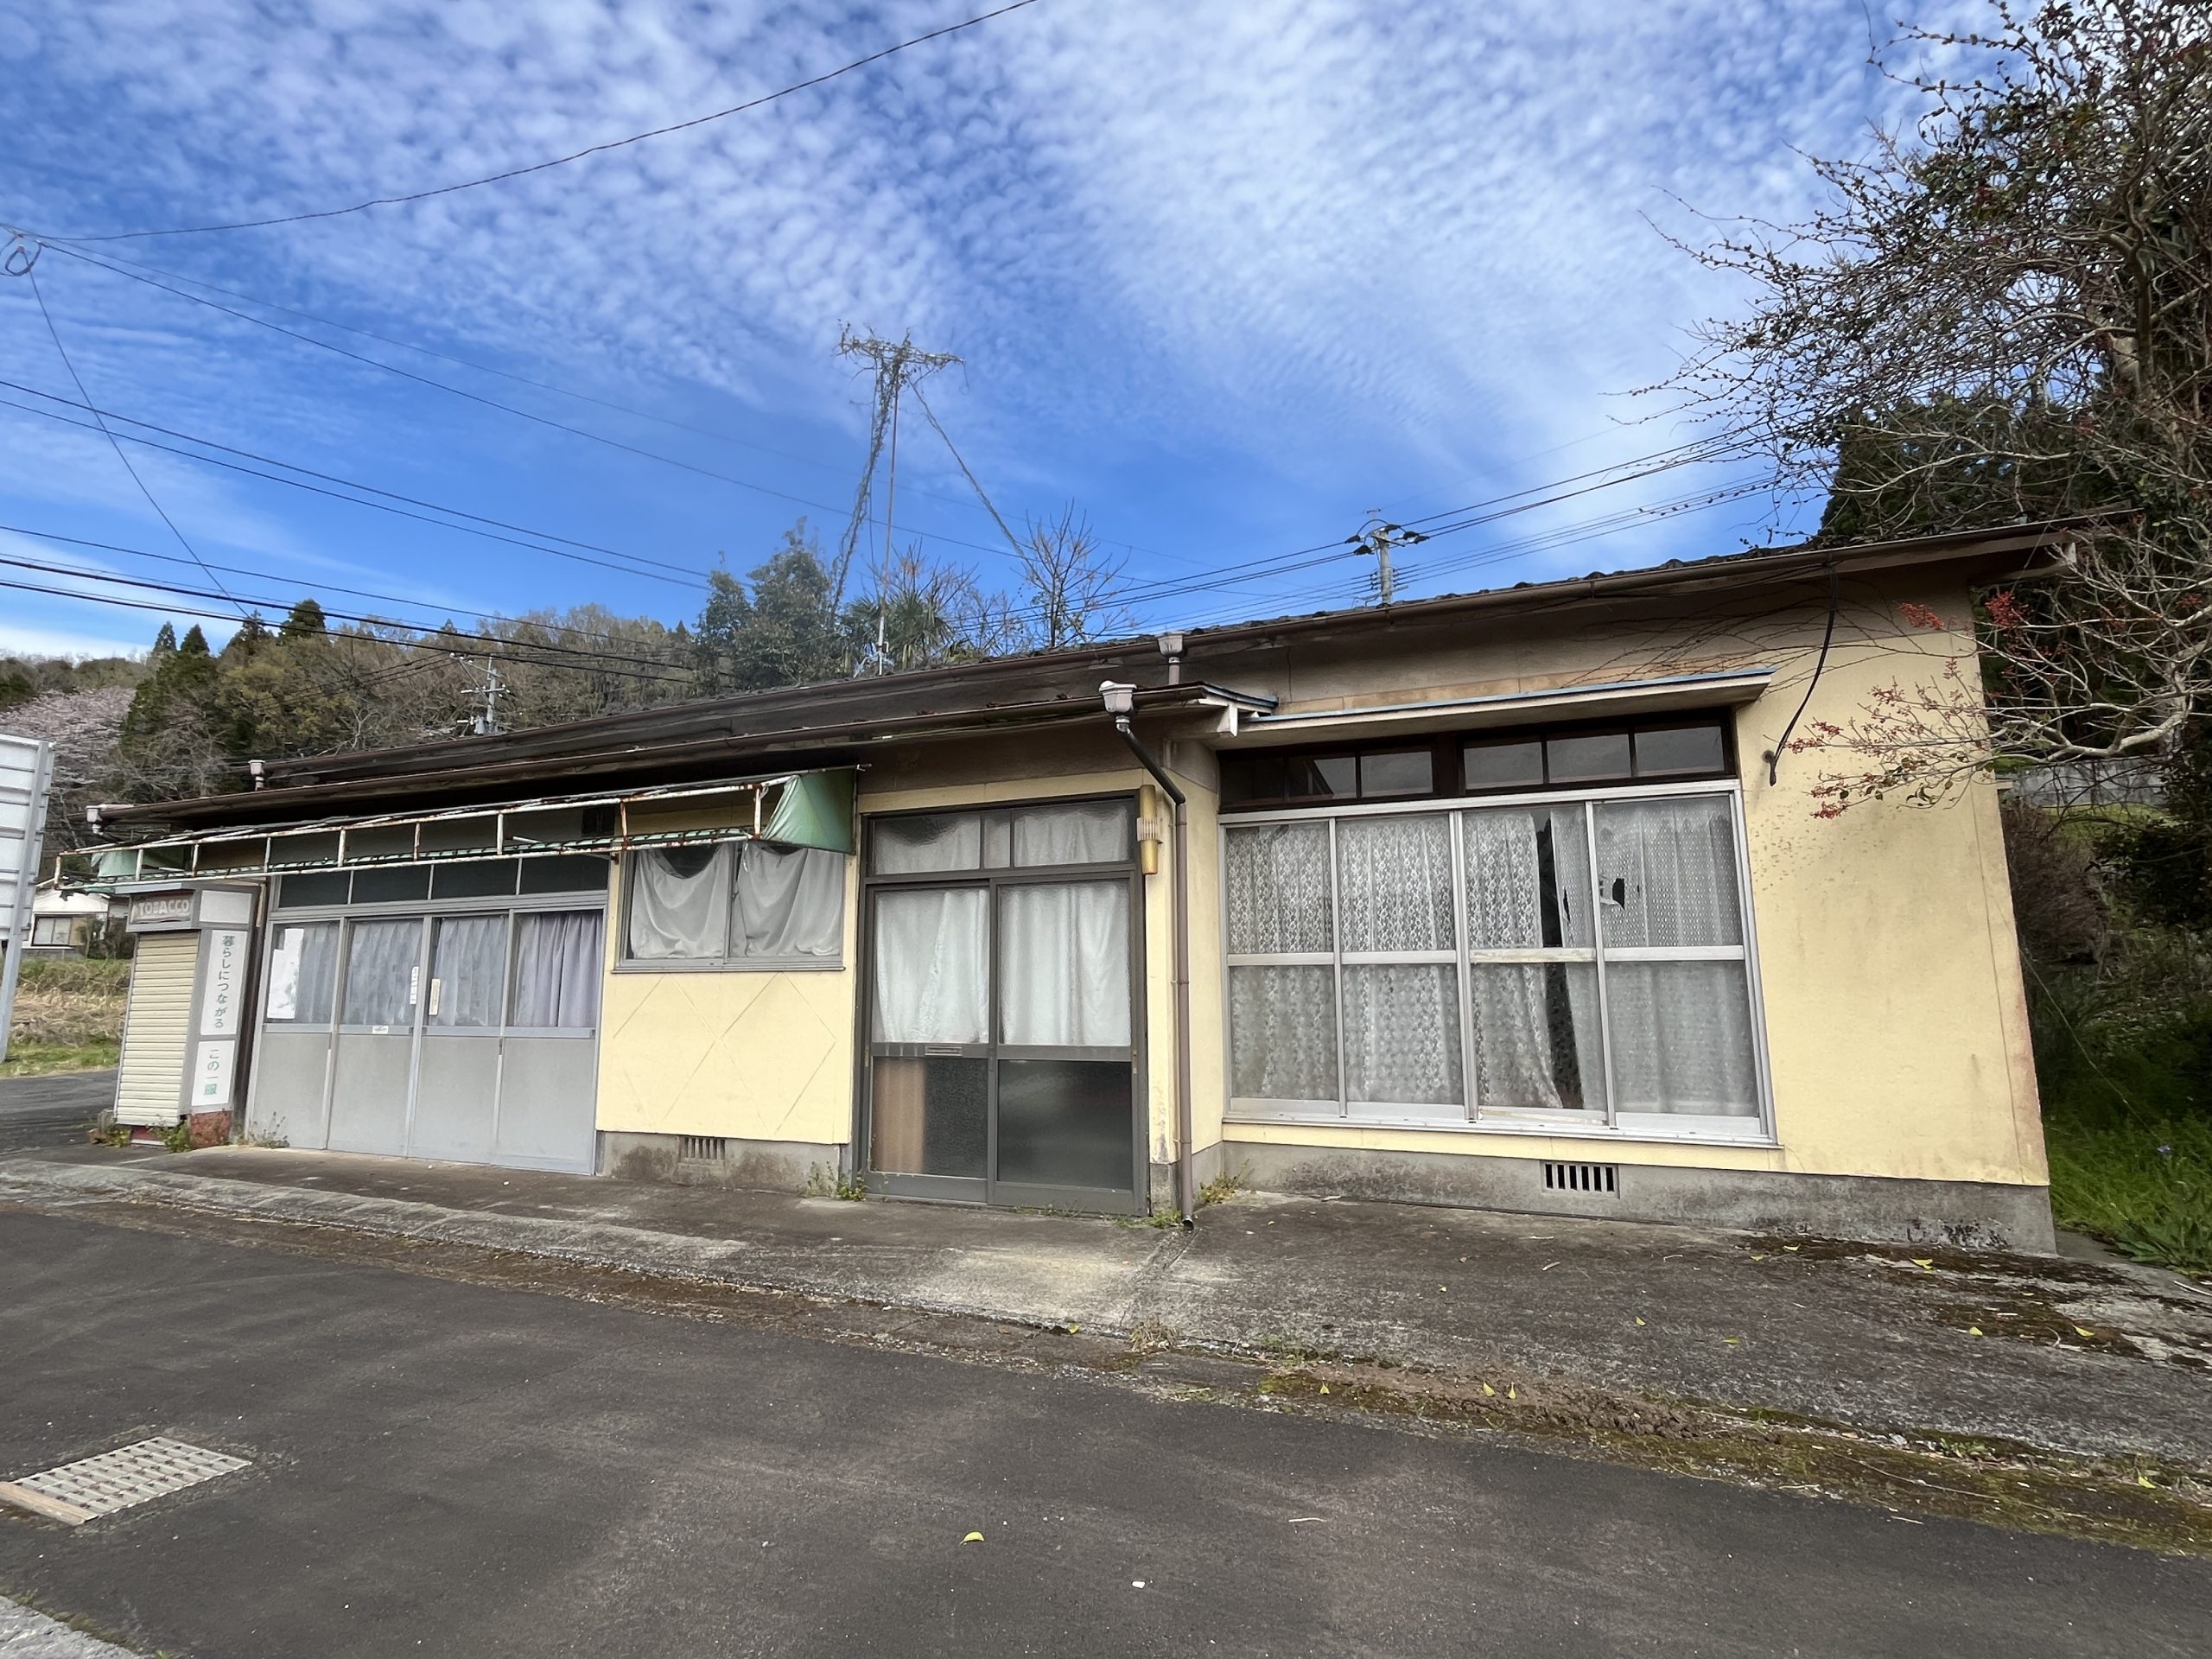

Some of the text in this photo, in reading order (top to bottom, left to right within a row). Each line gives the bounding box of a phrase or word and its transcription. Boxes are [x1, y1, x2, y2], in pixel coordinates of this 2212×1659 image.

[139, 899, 189, 916] TOBACCO
[213, 935, 235, 1029] 暮らしにつながる
[203, 1049, 219, 1096] この一服
